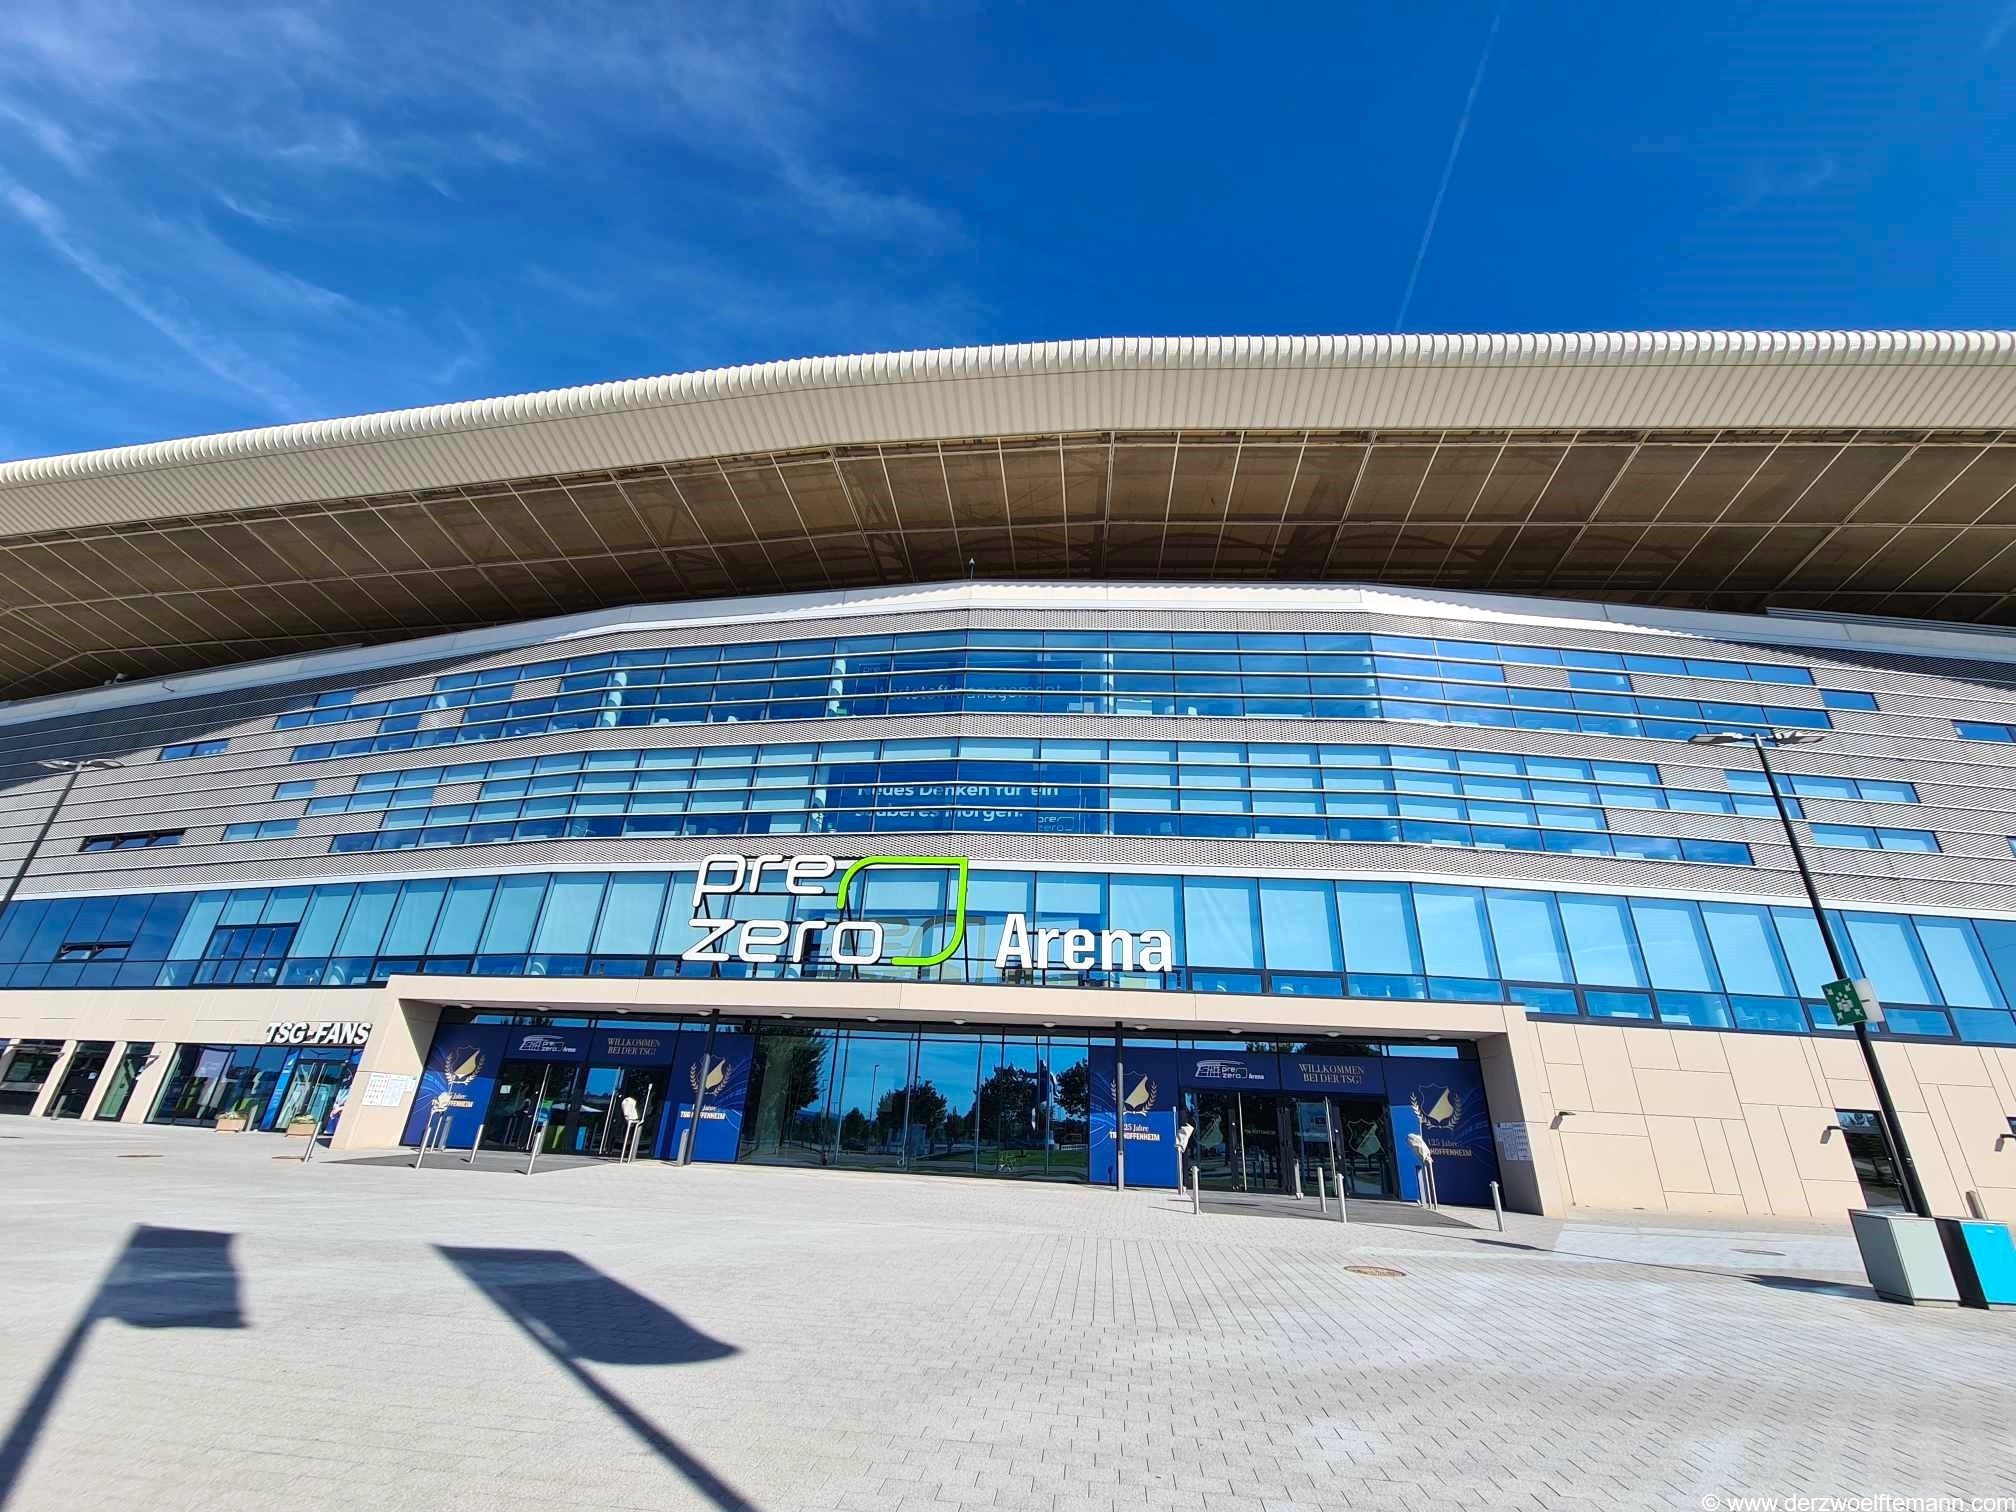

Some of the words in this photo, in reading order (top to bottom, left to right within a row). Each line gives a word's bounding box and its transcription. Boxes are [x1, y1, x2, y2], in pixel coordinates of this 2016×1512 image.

[919, 785, 990, 797] Denken
[1031, 785, 1059, 797] ein
[691, 853, 838, 908] pre
[680, 917, 884, 966] zero
[994, 912, 1174, 972] Arena
[265, 1021, 371, 1045] TSG-FANS
[607, 1037, 661, 1048] WILLKOMMEN
[1298, 1063, 1365, 1075] WILLKOMMEN
[1303, 1073, 1318, 1082] BEI
[1319, 1073, 1339, 1083] DER
